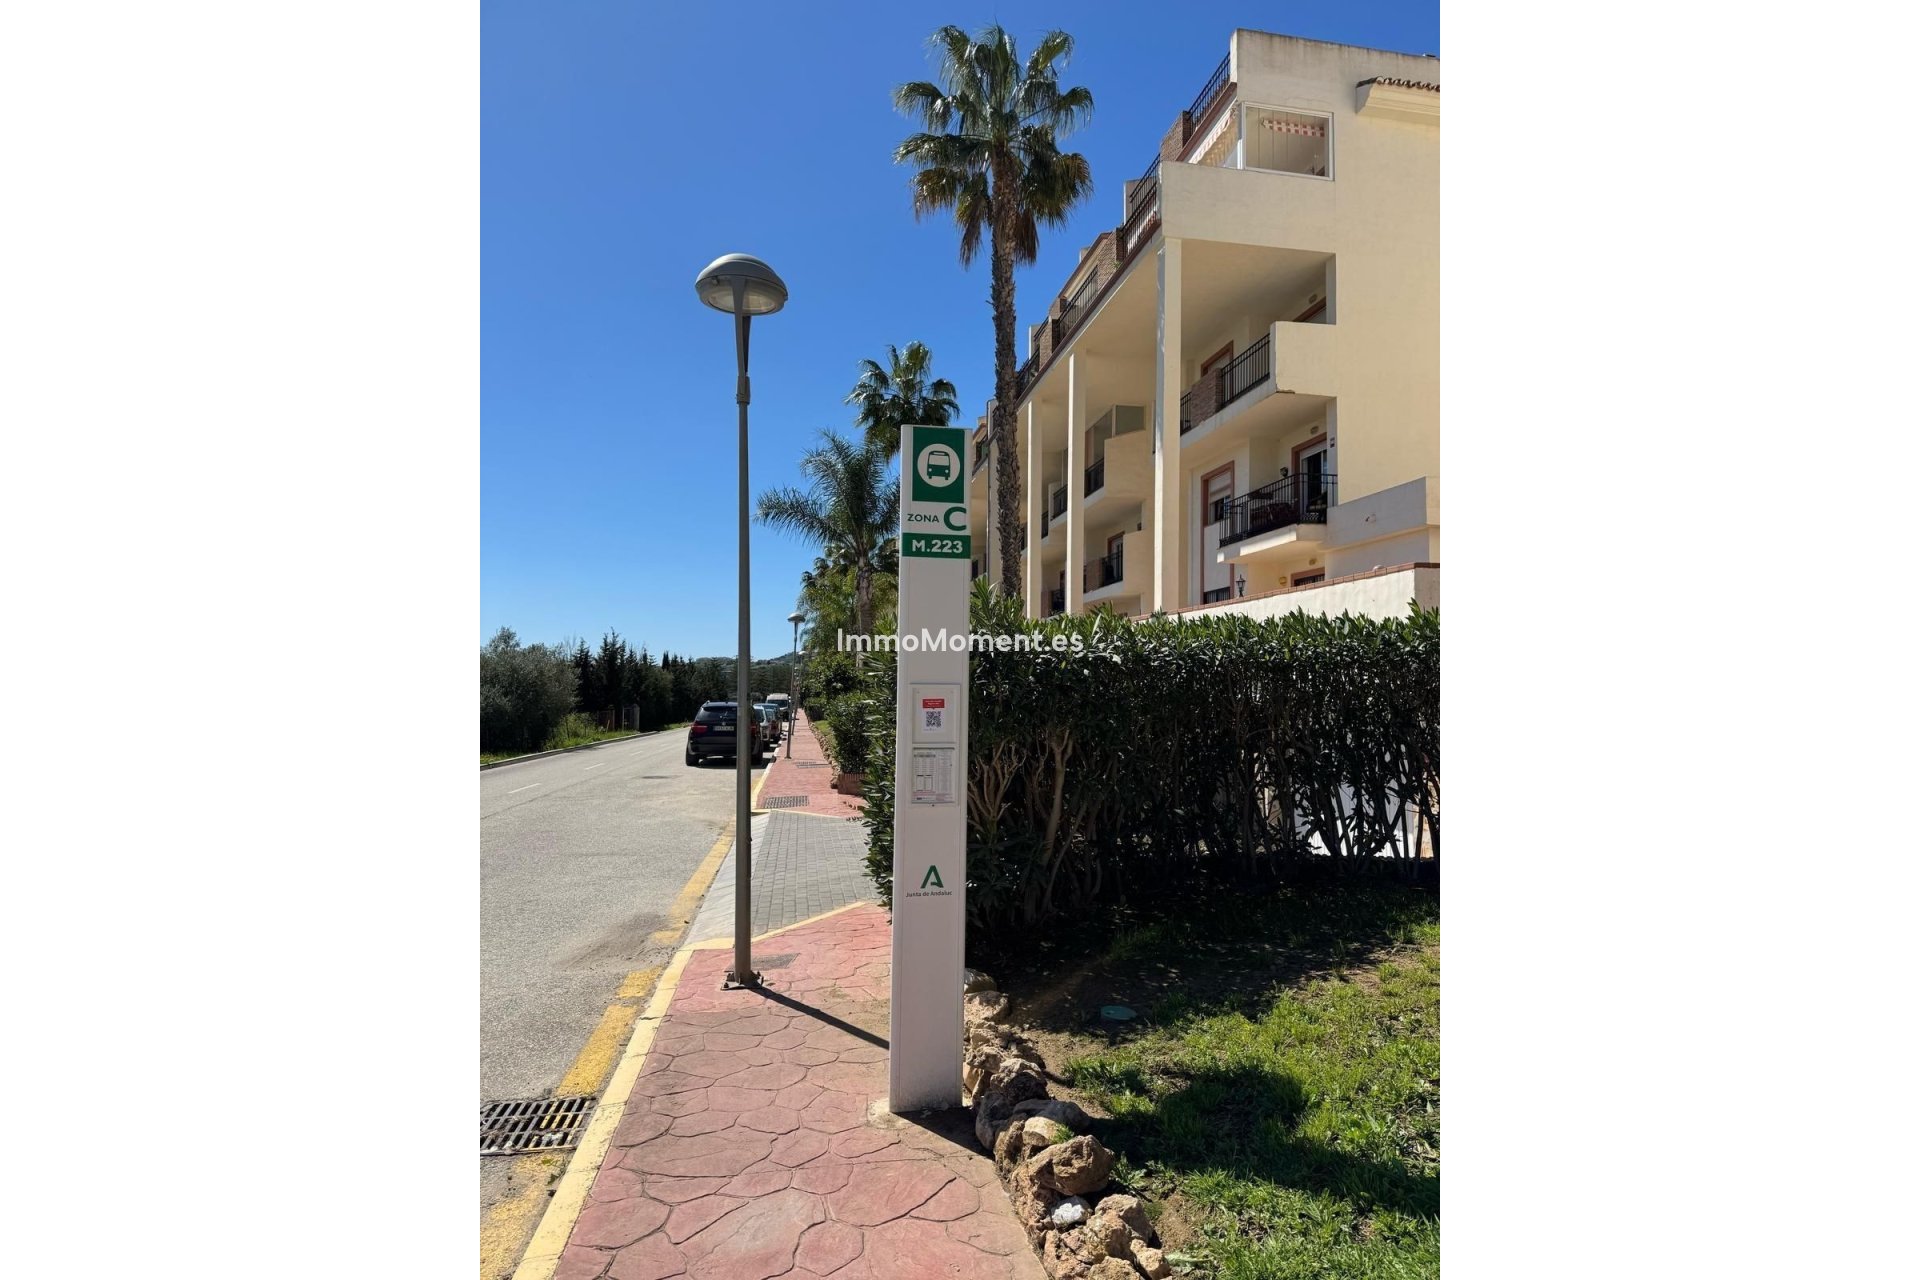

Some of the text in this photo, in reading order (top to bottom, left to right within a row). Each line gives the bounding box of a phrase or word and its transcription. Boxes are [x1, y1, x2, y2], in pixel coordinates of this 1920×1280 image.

[907, 506, 967, 531] ZONA C
[911, 538, 963, 554] M.223
